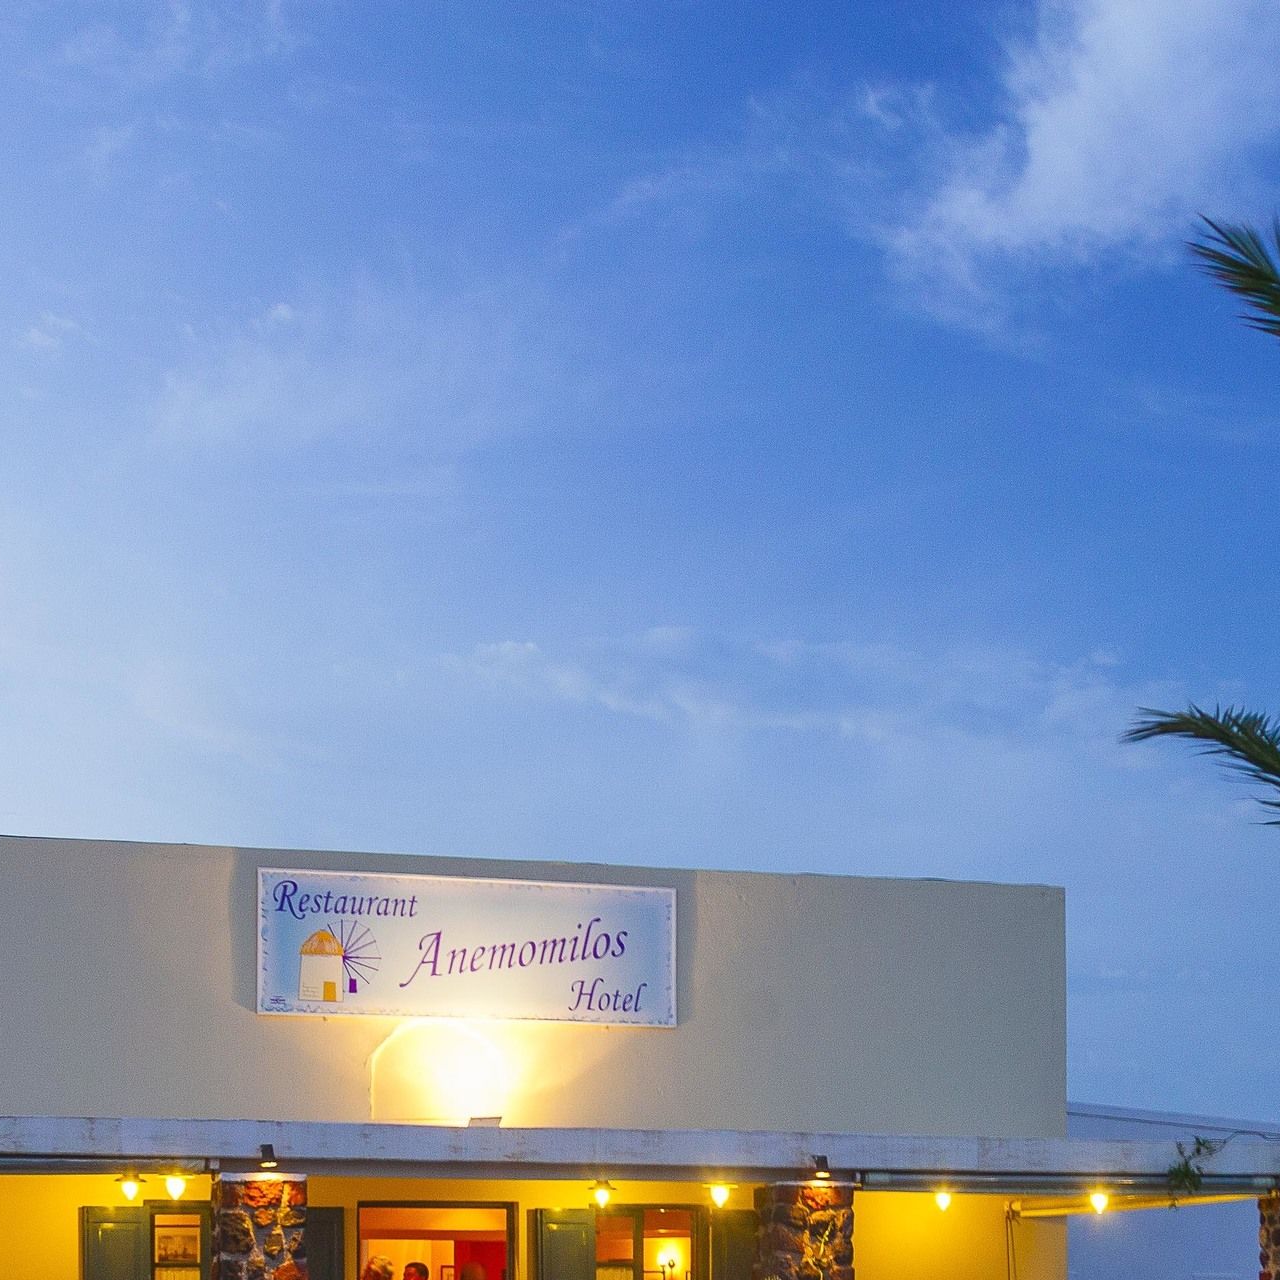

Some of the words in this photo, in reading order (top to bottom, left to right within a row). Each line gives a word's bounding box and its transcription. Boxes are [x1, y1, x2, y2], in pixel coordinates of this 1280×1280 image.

[273, 880, 418, 920] Restaurant
[399, 917, 628, 988] Anemomilos
[568, 977, 648, 1013] Hotel
